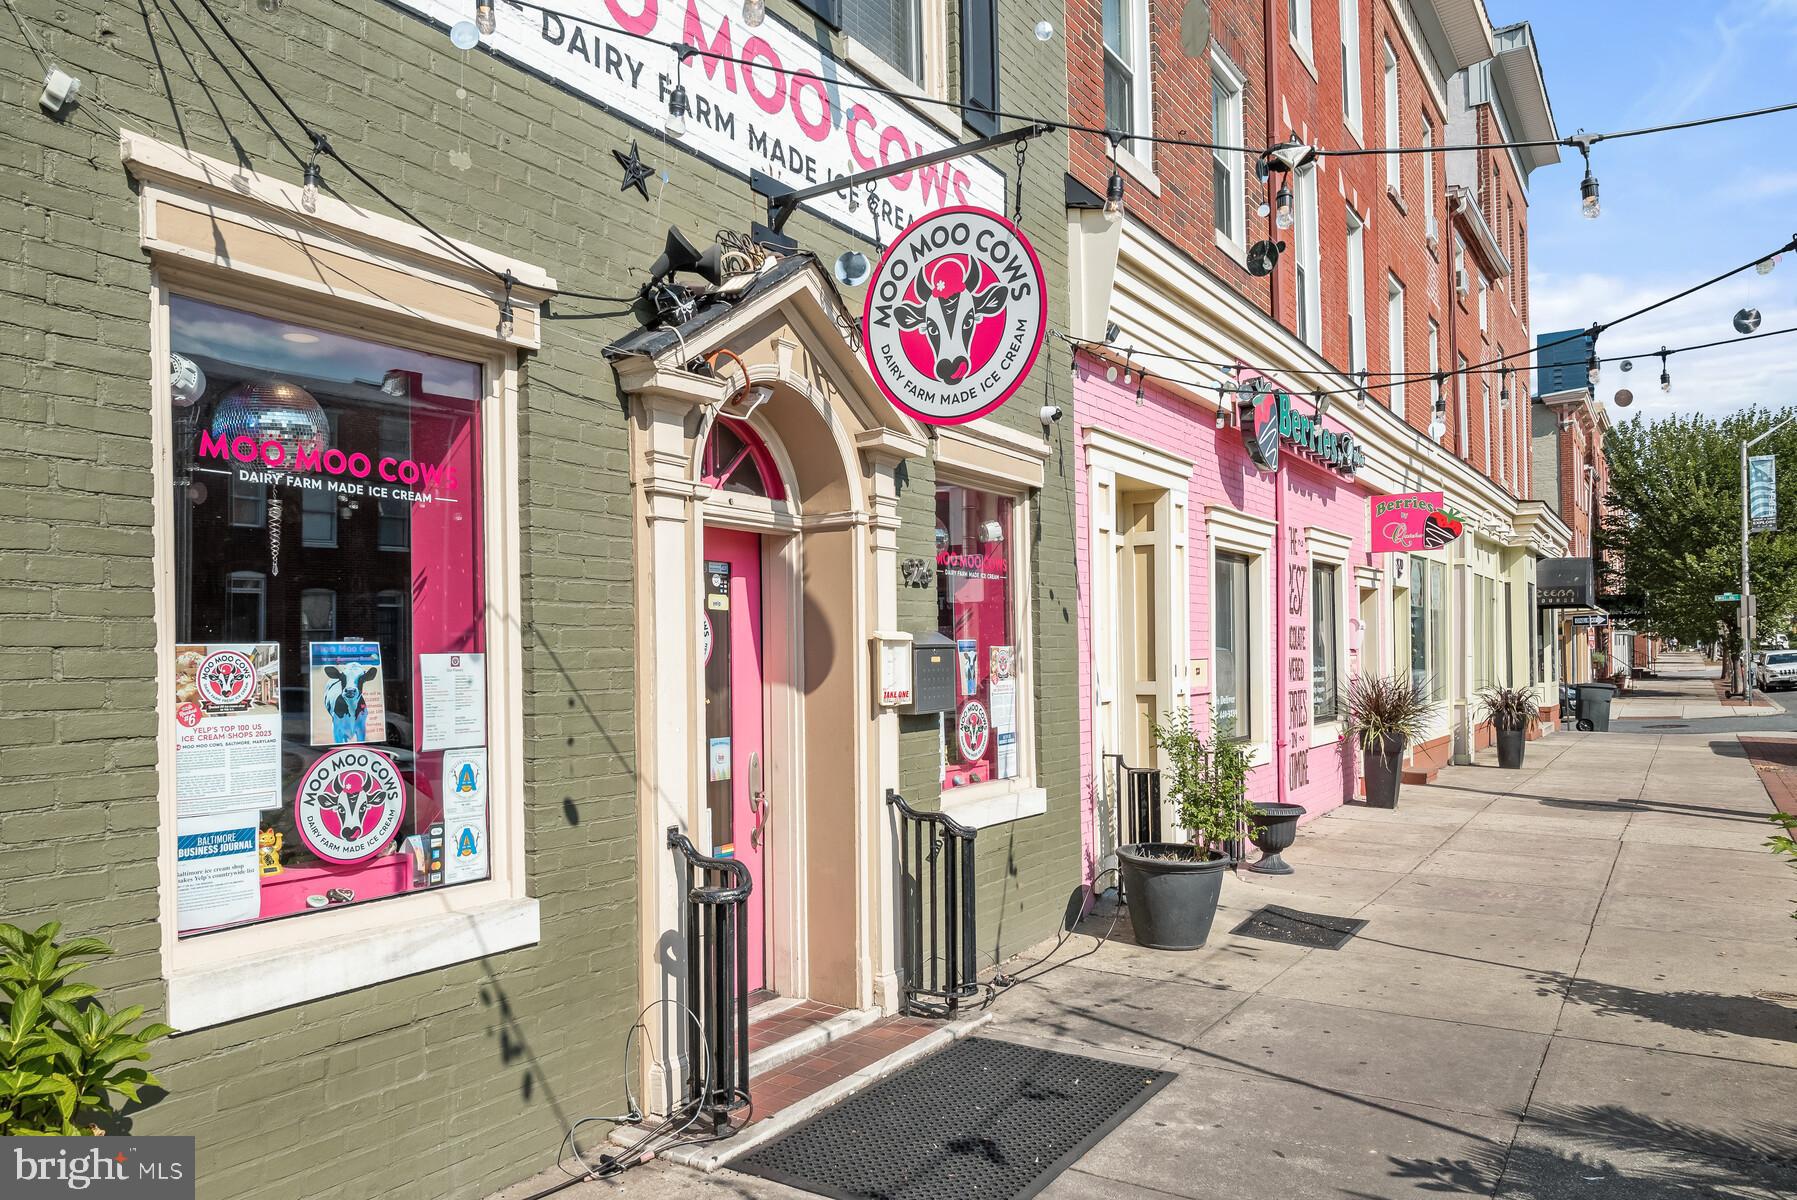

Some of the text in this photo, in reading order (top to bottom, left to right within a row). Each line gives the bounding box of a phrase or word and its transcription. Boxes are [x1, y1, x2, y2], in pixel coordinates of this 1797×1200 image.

[682, 0, 832, 142] MOO
[542, 9, 644, 89] DAIRY
[659, 72, 735, 140] FRM
[749, 123, 817, 184] MADE
[873, 222, 1031, 329] MOO MOO COWS
[881, 319, 1027, 405] DAIRY FARM MADE ICE CREAM
[199, 429, 458, 491] MOO MOO COWS
[239, 469, 432, 503] DAIRY FARM MADE ICE CREAM
[1376, 496, 1434, 518] Berries
[959, 555, 981, 569] MOO
[202, 655, 251, 680] MOO MOO COWS
[883, 690, 910, 699] TAKE ONE
[193, 724, 218, 734] YELP'S
[959, 710, 968, 731] MOO
[967, 703, 979, 713] MOO
[978, 708, 988, 730] COWS
[197, 733, 225, 741] CREAM
[228, 731, 253, 740] SHOPS
[255, 730, 272, 738] 2023
[303, 768, 330, 806] MOO
[332, 754, 369, 772] MOO
[371, 761, 399, 801] COWS
[197, 832, 237, 846] BALTIMORE
[307, 809, 396, 853] DAIRY FARM MADE ICE CREAM
[178, 840, 254, 858] BUSINESS JOURNAL
[194, 874, 212, 882] Yelp's
[212, 870, 246, 879] countrywide
[231, 863, 245, 872] shop
